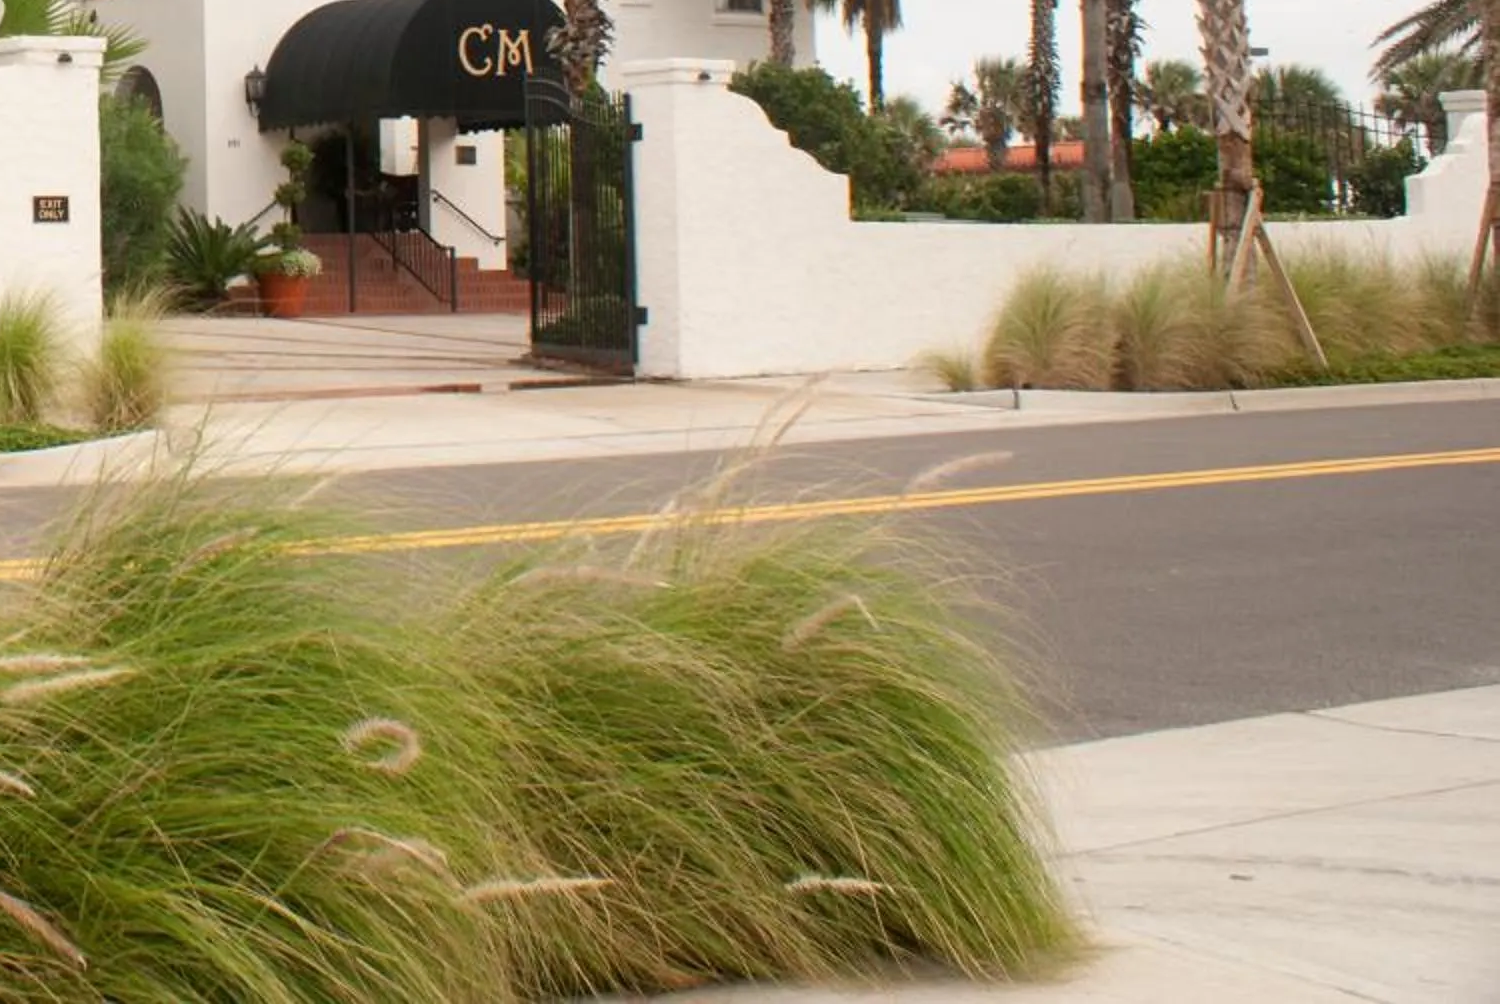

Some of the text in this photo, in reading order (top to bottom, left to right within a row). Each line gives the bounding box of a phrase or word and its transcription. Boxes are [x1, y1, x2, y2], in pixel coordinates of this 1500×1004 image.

[458, 23, 534, 77] CM
[39, 199, 63, 209] EXIT
[37, 209, 65, 221] ONLY
